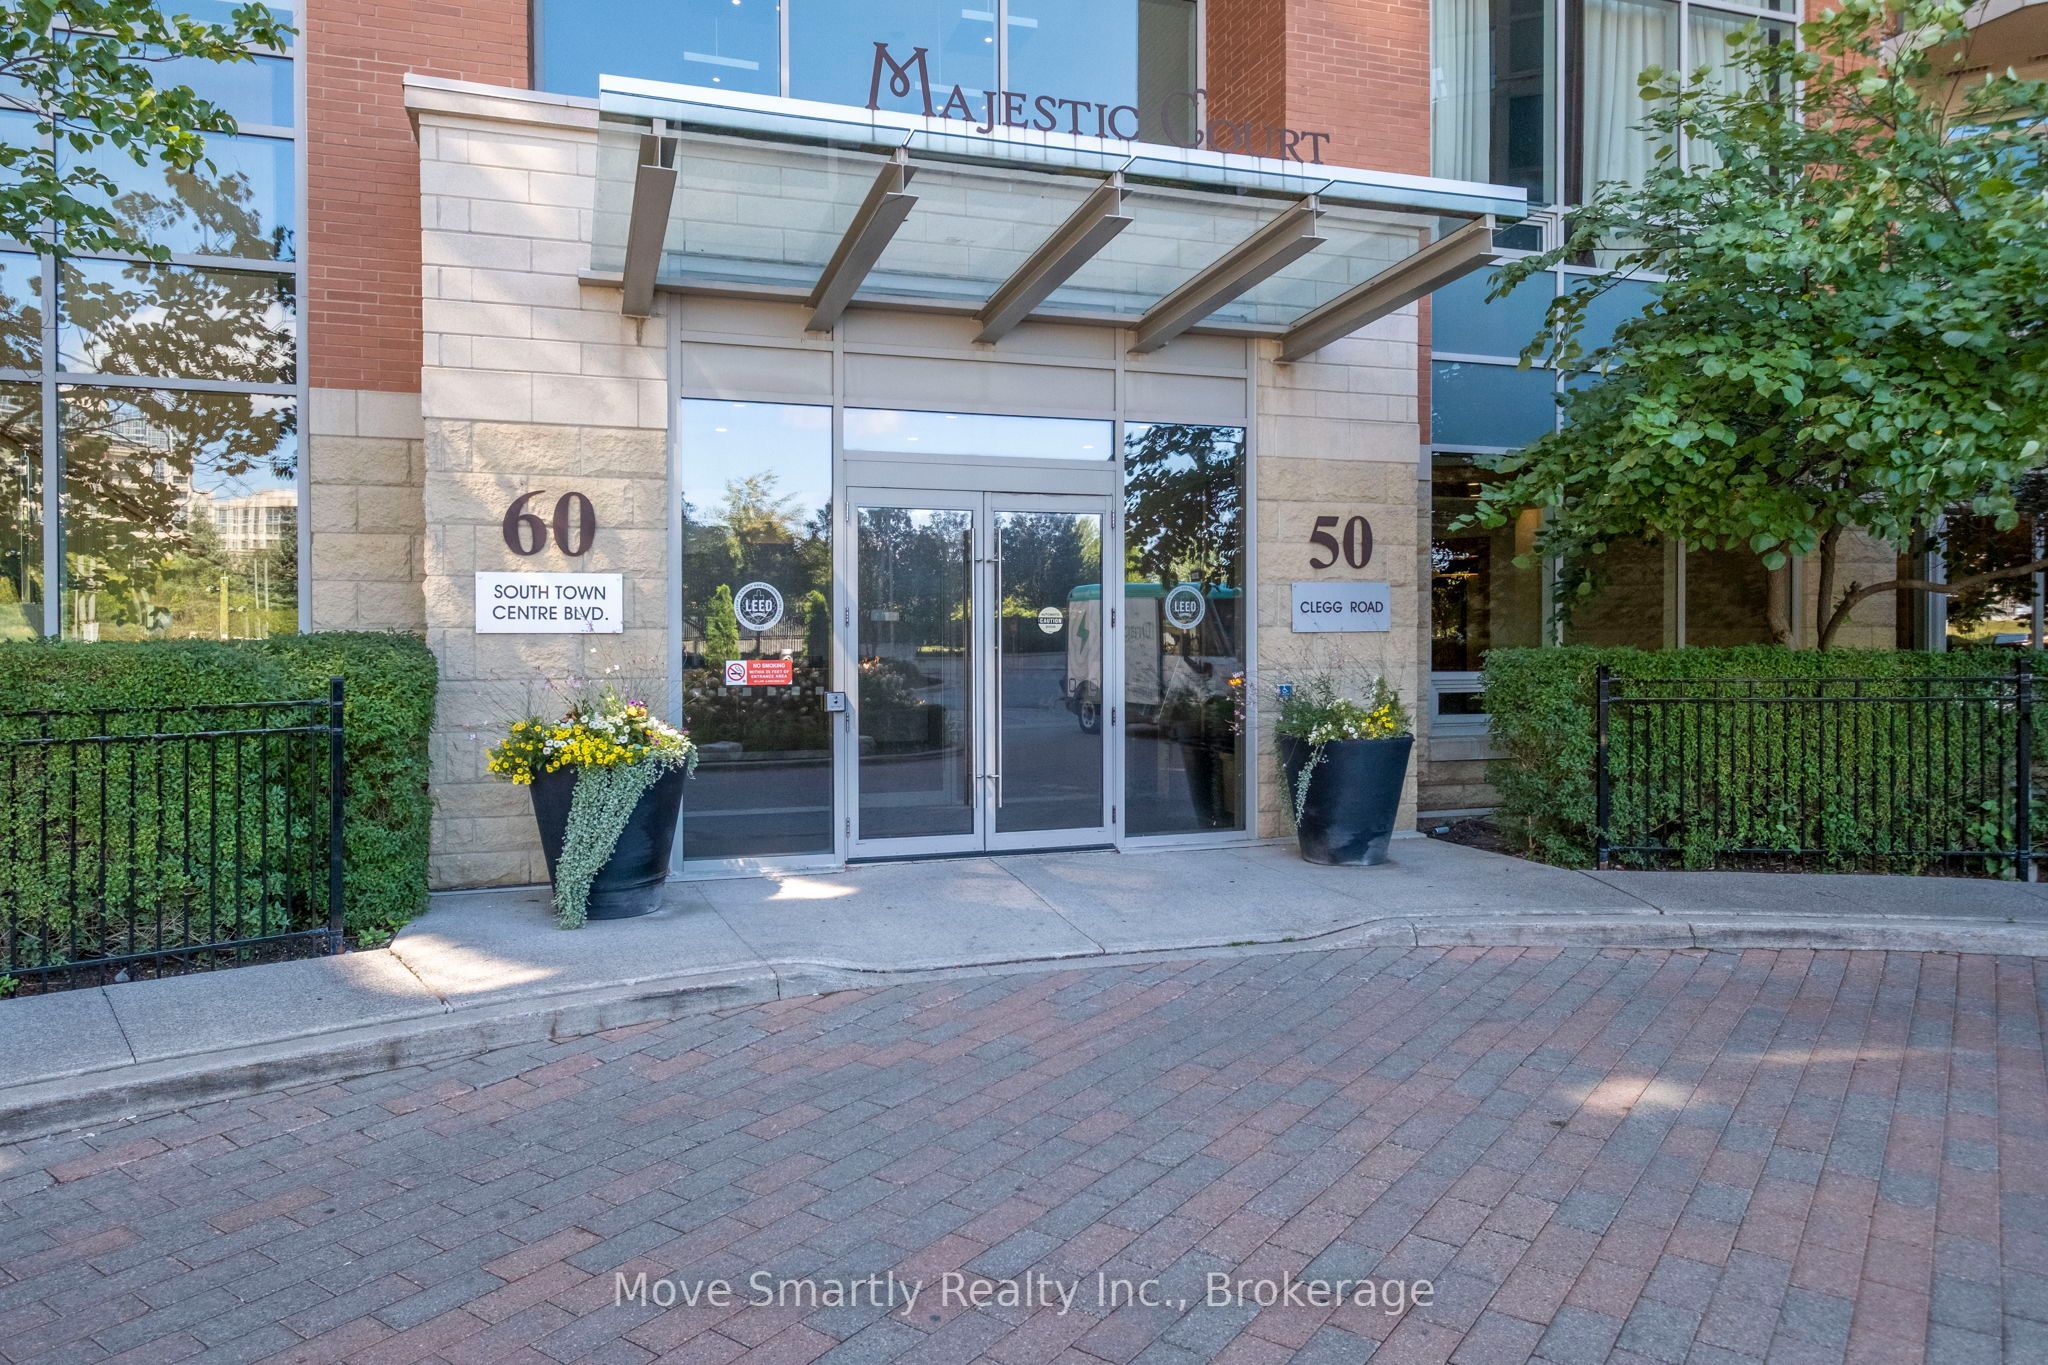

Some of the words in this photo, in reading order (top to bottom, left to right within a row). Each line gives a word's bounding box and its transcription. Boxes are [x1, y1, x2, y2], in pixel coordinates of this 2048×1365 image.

[865, 41, 1140, 142] MAJESTIC
[1161, 88, 1330, 165] COURT
[502, 489, 596, 557] 60
[1309, 515, 1373, 569] 50
[493, 584, 549, 600] SOUTH
[554, 585, 606, 601] TOWN
[492, 605, 558, 621] CENTRE
[563, 606, 609, 621] BLVD.
[745, 599, 773, 612] LEED
[1174, 600, 1197, 612] LEED
[1300, 601, 1343, 614] CLEGG
[1350, 601, 1384, 613] ROAD
